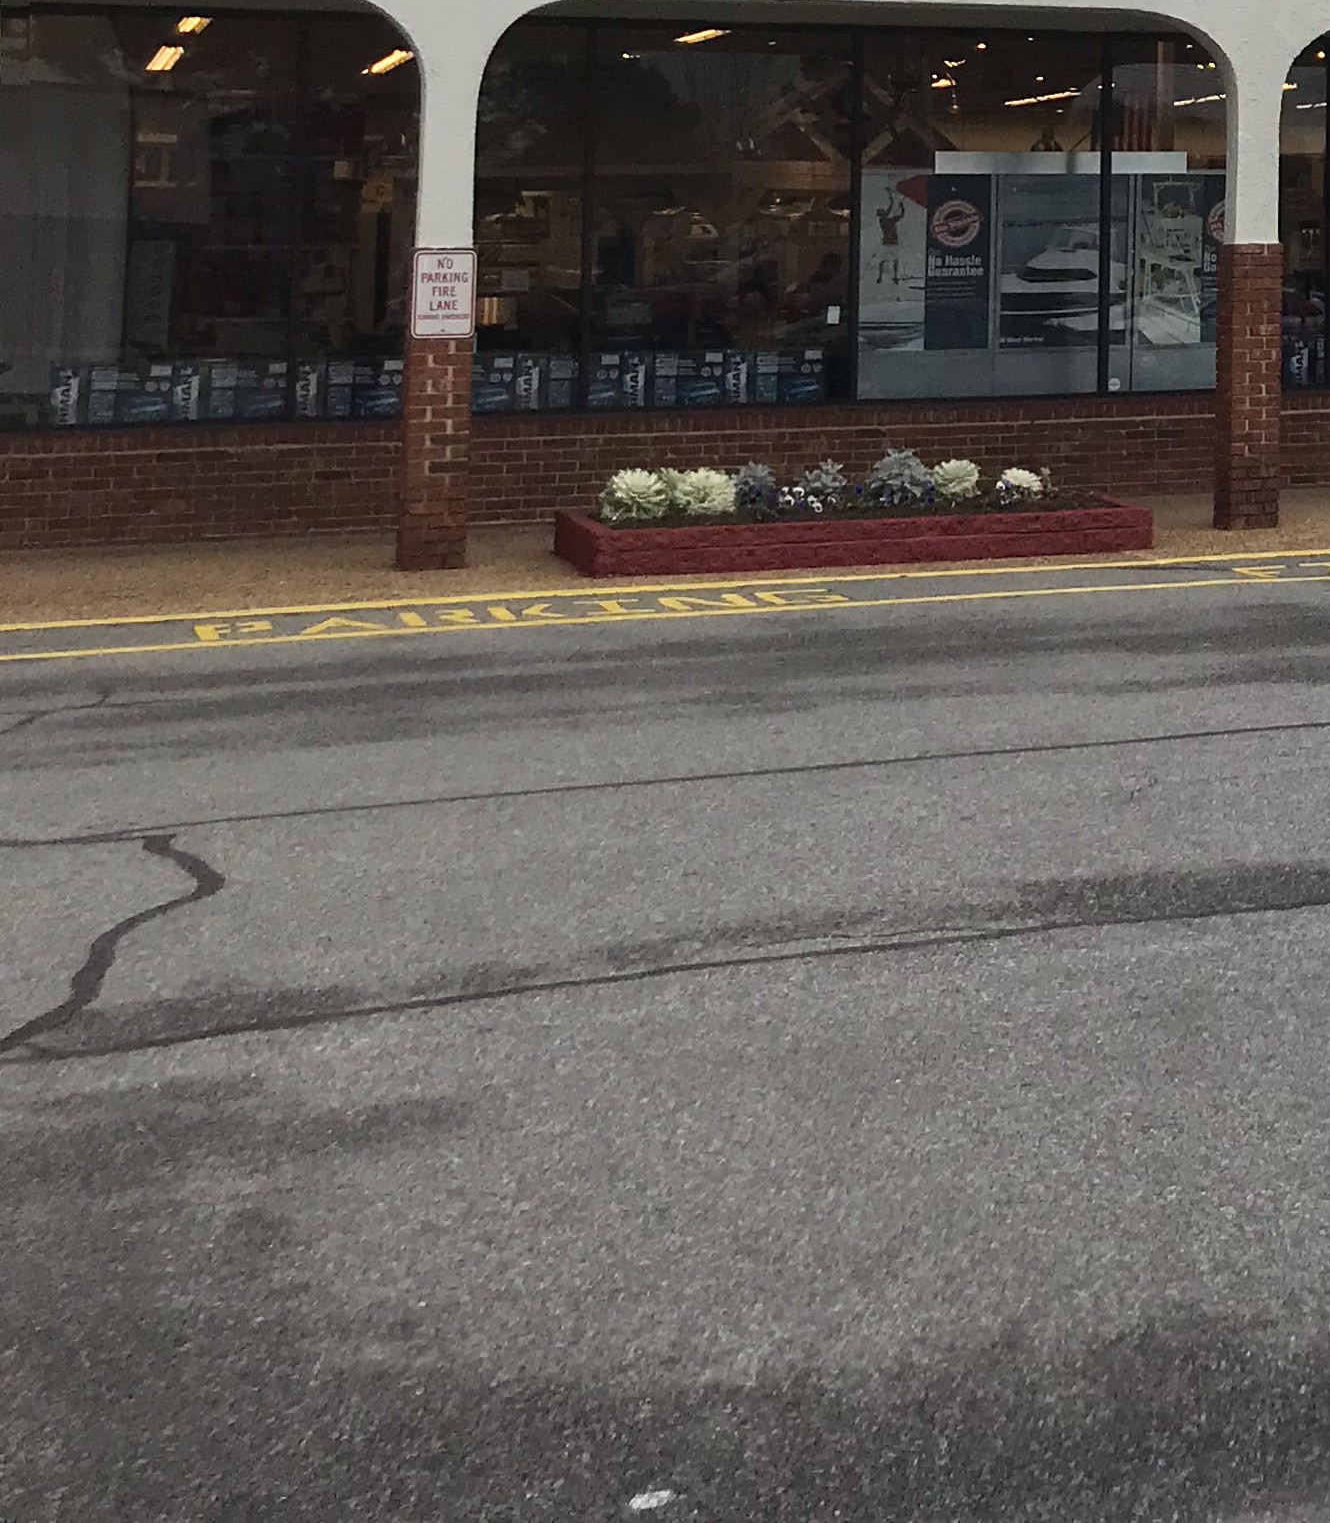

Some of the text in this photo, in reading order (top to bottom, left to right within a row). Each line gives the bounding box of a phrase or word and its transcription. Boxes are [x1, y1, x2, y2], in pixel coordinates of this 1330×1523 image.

[437, 258, 453, 269] NO
[927, 254, 982, 266] No Hassle
[927, 266, 984, 277] Guarantee
[421, 272, 469, 283] PARKING
[432, 286, 457, 297] FIRE
[429, 300, 458, 311] LANE
[193, 589, 850, 641] PARKING
